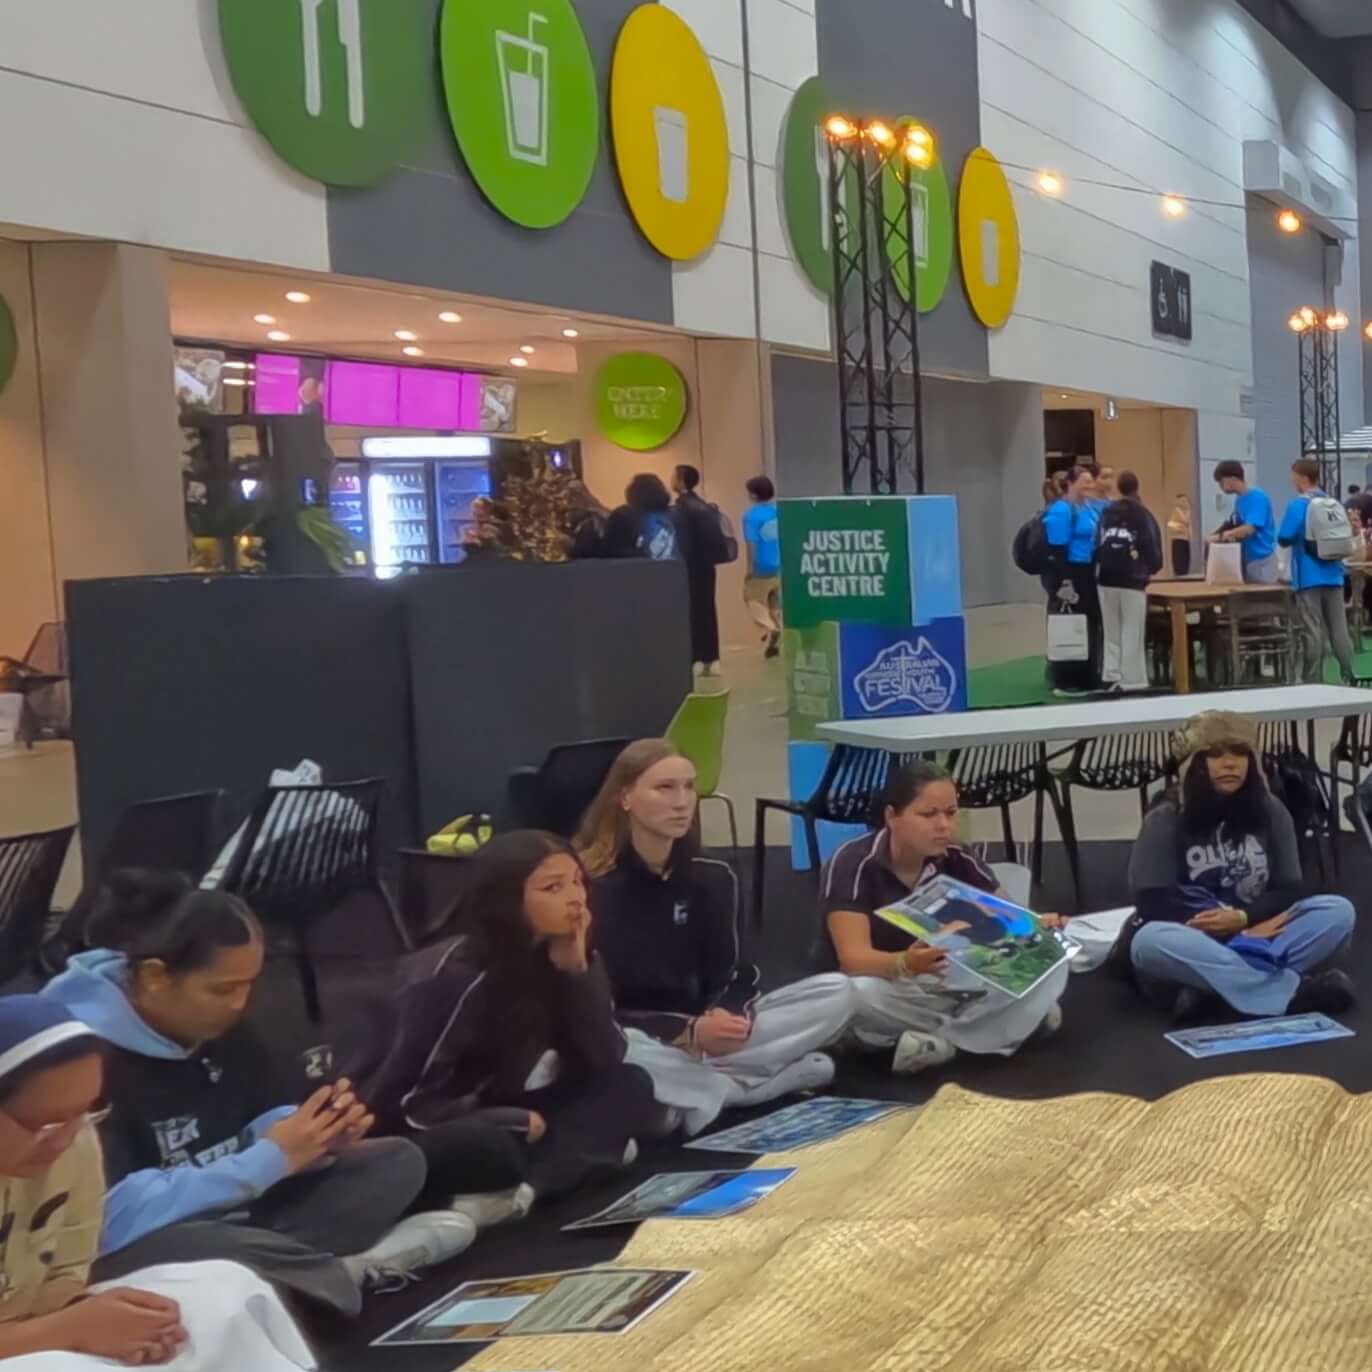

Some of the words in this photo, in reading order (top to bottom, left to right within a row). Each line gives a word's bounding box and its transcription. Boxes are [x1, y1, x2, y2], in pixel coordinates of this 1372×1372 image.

[803, 529, 886, 551] JUSTICE
[800, 552, 890, 575] ACTIVITY
[807, 575, 885, 597] CENTRE
